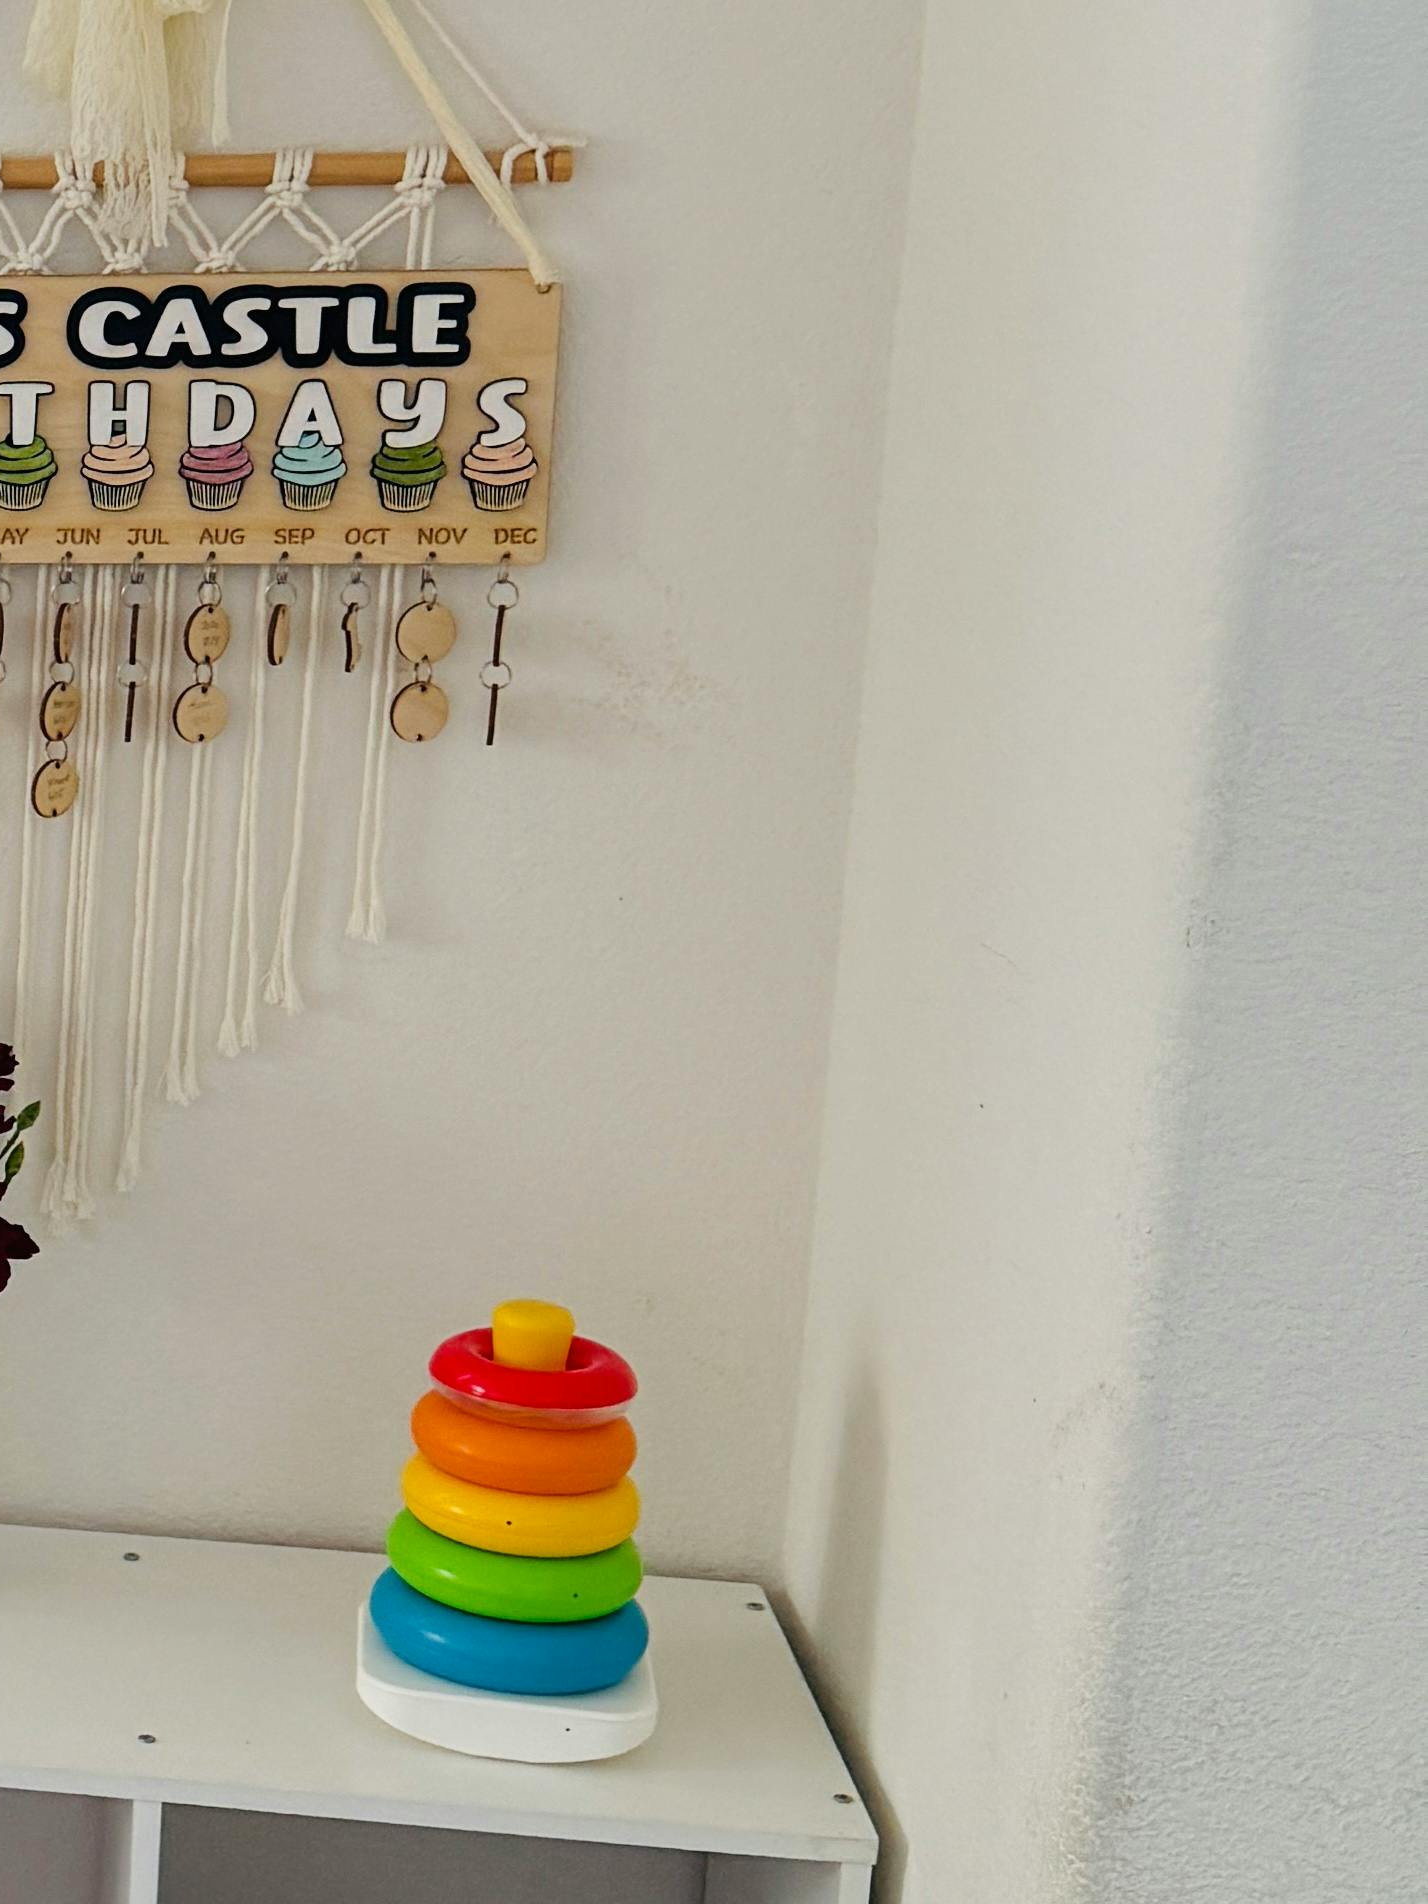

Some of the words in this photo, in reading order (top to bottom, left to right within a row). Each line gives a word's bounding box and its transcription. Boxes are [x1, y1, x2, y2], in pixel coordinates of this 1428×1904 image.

[73, 289, 470, 365] CASTLE
[55, 527, 101, 546] JUN
[127, 527, 170, 546] JUL
[198, 527, 245, 546] AUG
[273, 527, 315, 546] SEP
[344, 527, 391, 546] OCT
[417, 527, 469, 546] NOV
[494, 527, 538, 546] DEC
